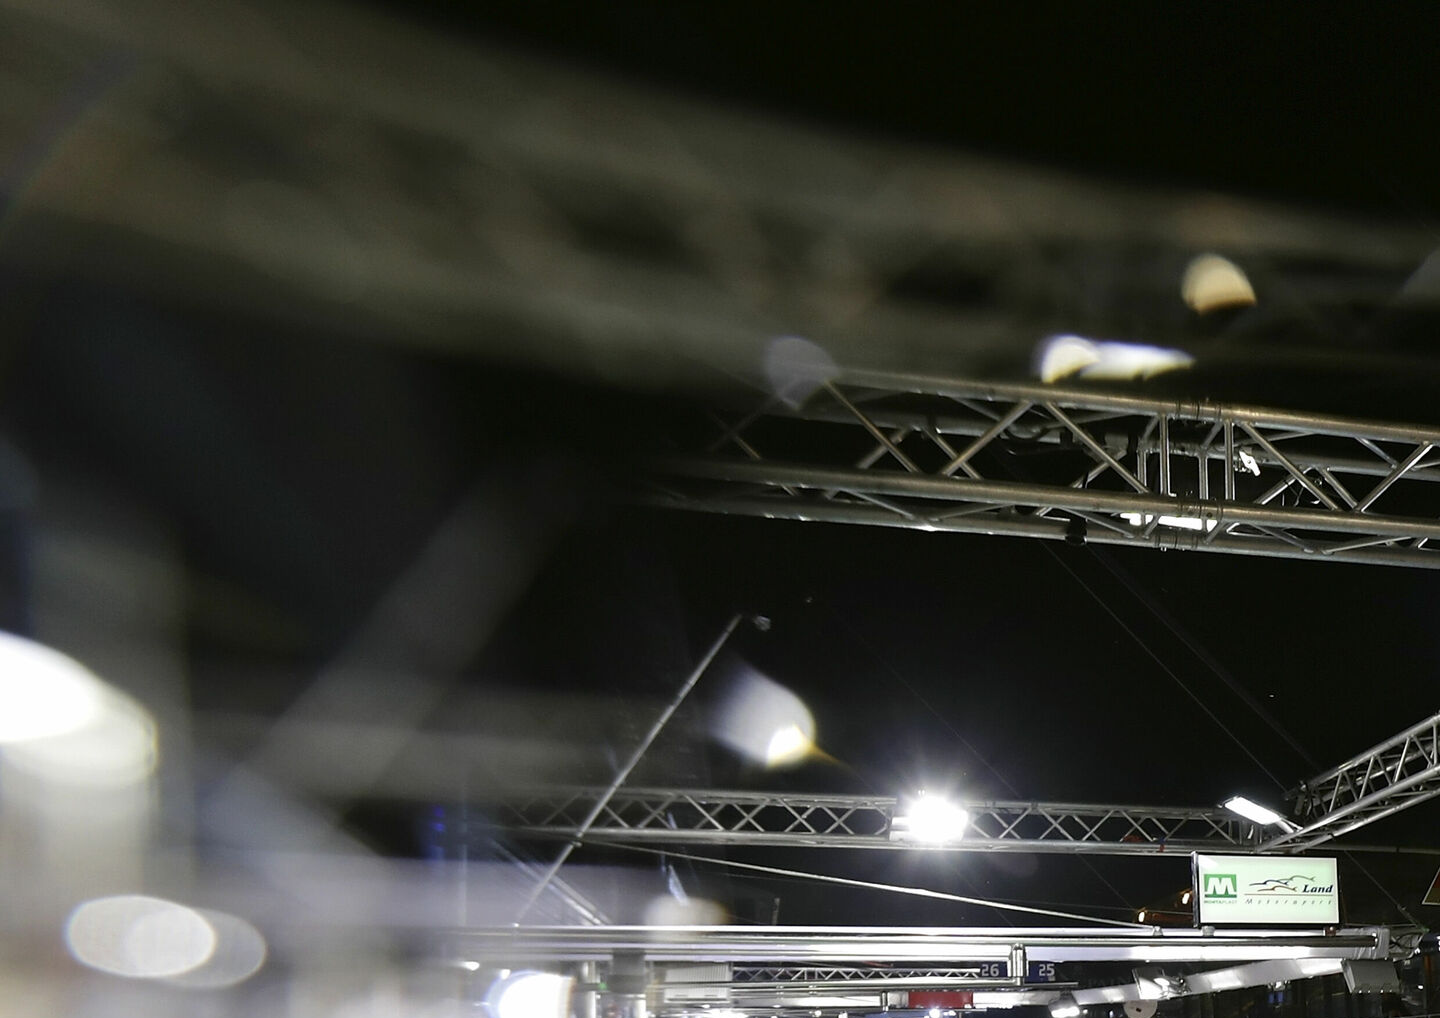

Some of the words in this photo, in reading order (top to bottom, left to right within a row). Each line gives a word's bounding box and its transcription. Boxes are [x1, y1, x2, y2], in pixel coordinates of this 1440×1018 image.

[1302, 884, 1333, 893] Land
[981, 963, 1000, 977] 26
[1039, 963, 1055, 977] 25
